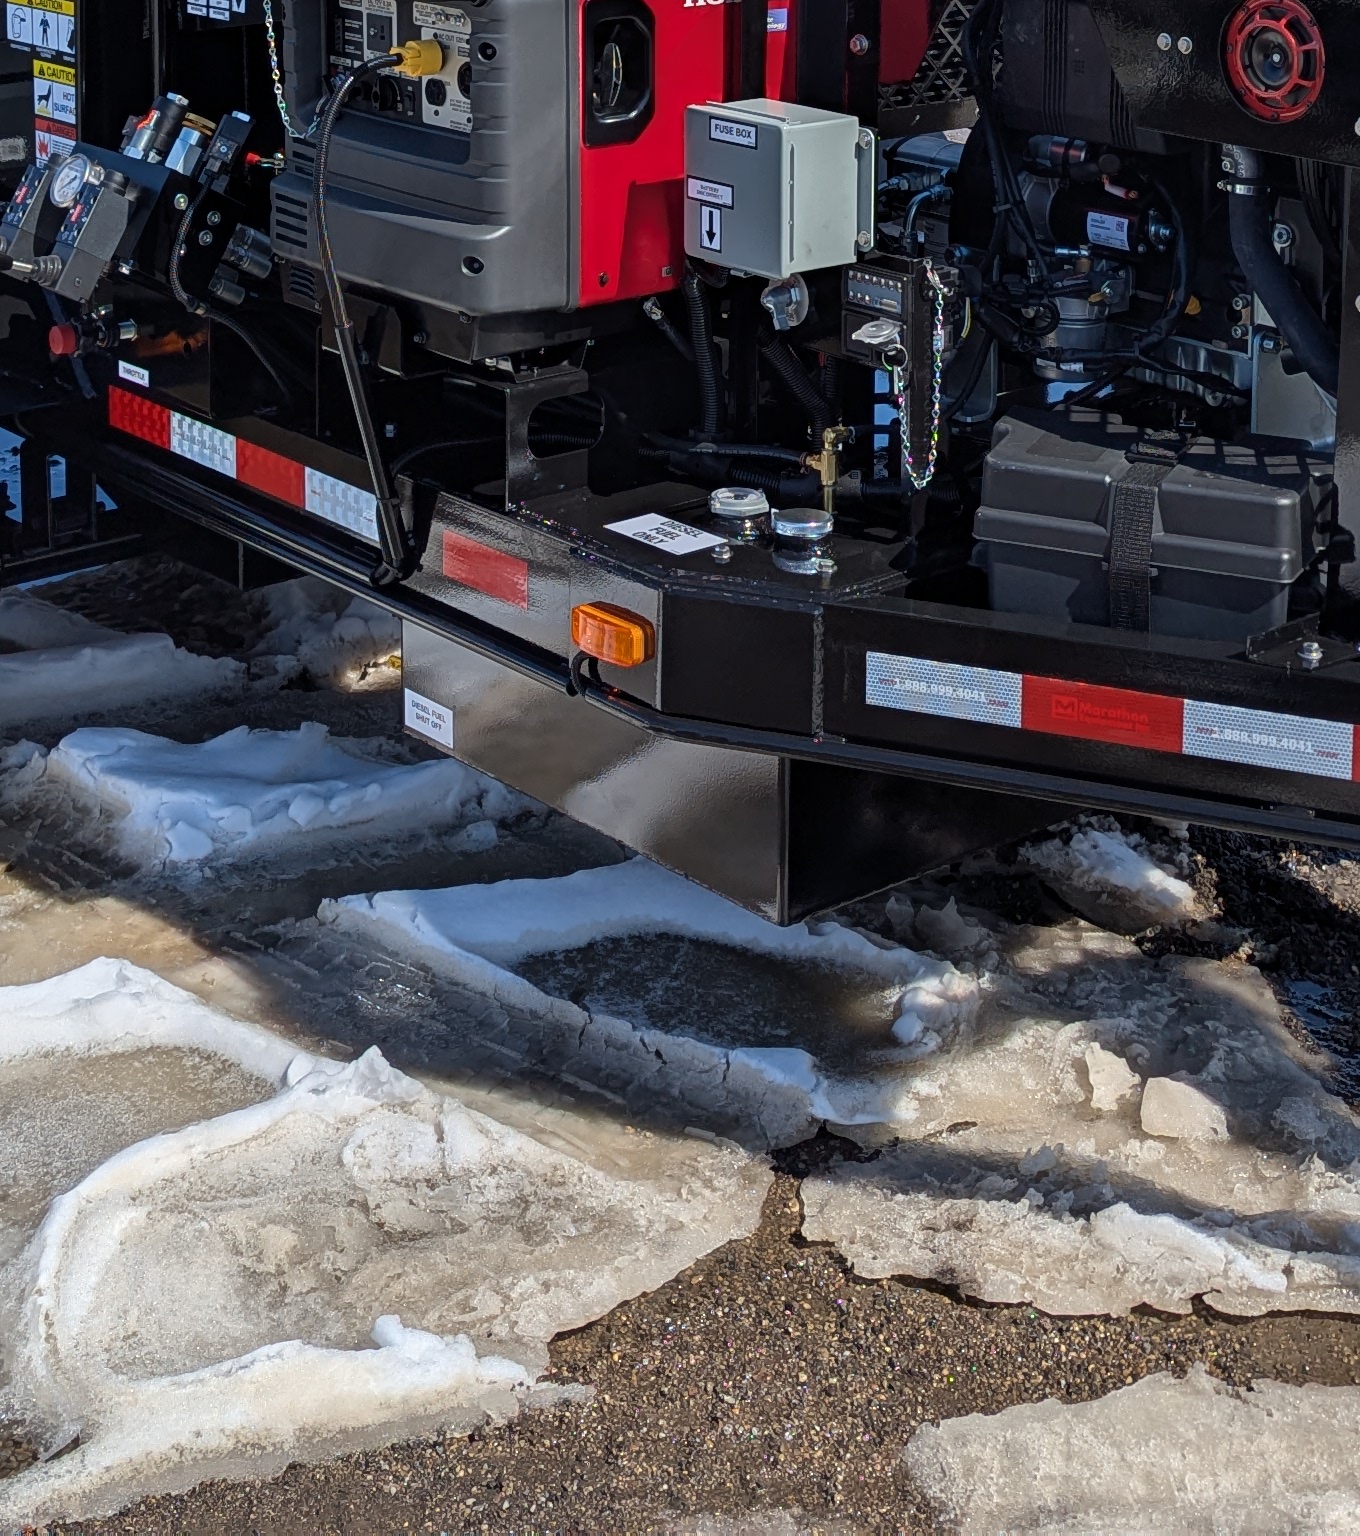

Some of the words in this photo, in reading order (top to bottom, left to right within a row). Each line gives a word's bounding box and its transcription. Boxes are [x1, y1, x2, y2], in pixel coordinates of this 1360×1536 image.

[63, 92, 74, 102] HOT
[714, 123, 734, 136] FUSE
[736, 127, 752, 139] BOX
[122, 365, 145, 381] THROTTLE
[648, 527, 681, 540] FUEL
[660, 520, 704, 538] DIESEL
[632, 531, 669, 544] ONLY
[412, 700, 430, 715] DIESEL
[432, 710, 446, 723] FUEL
[1078, 701, 1149, 723] Marathon
[416, 713, 430, 725] SHUT
[431, 721, 442, 731] OFF
